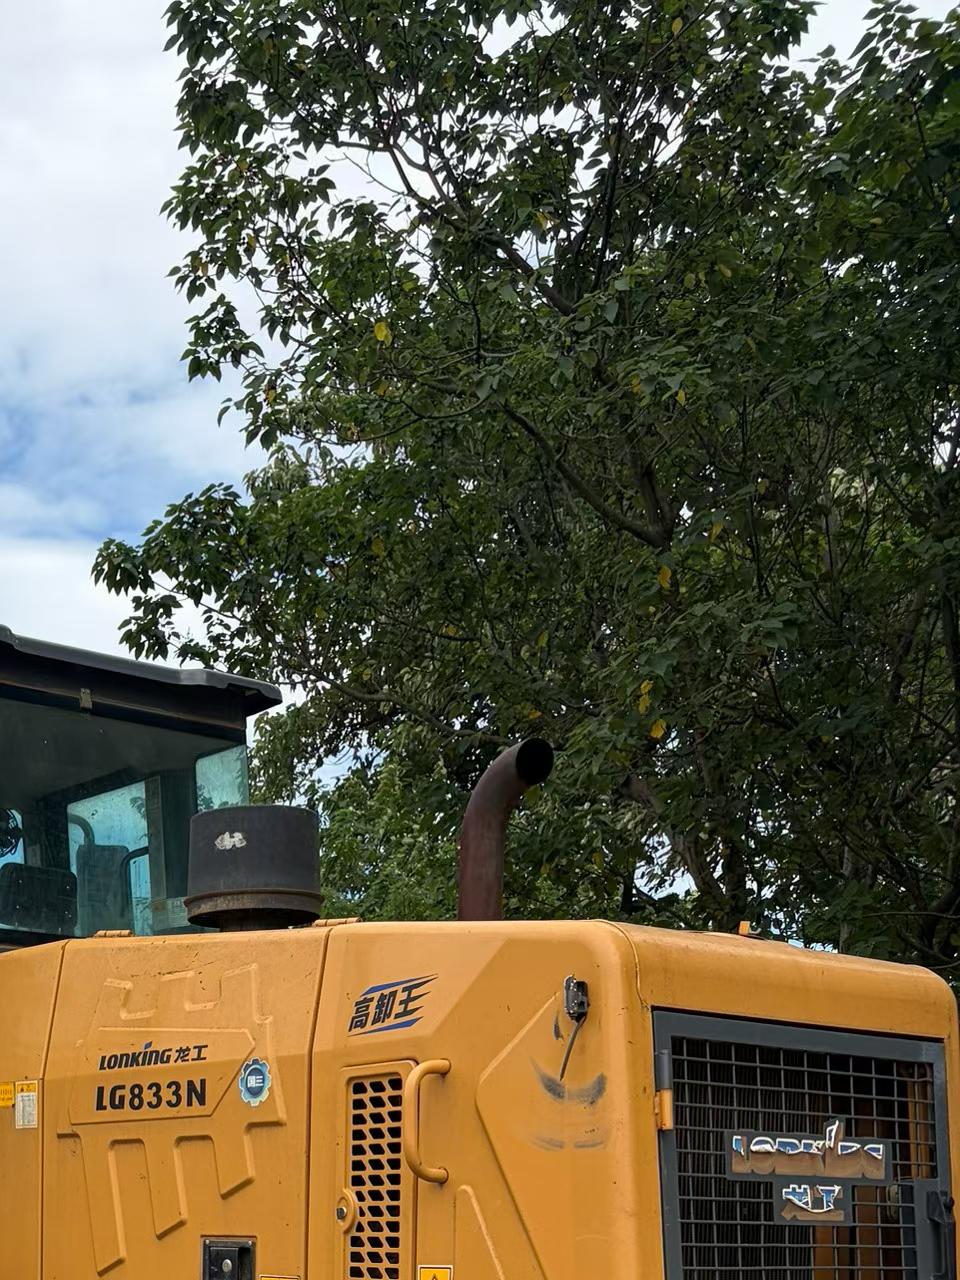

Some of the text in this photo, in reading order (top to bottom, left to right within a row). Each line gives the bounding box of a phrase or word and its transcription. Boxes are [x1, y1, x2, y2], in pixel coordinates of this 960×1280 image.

[348, 976, 439, 1032] 高卸王
[174, 1044, 208, 1063] 龙工
[95, 1078, 207, 1111] LG833N
